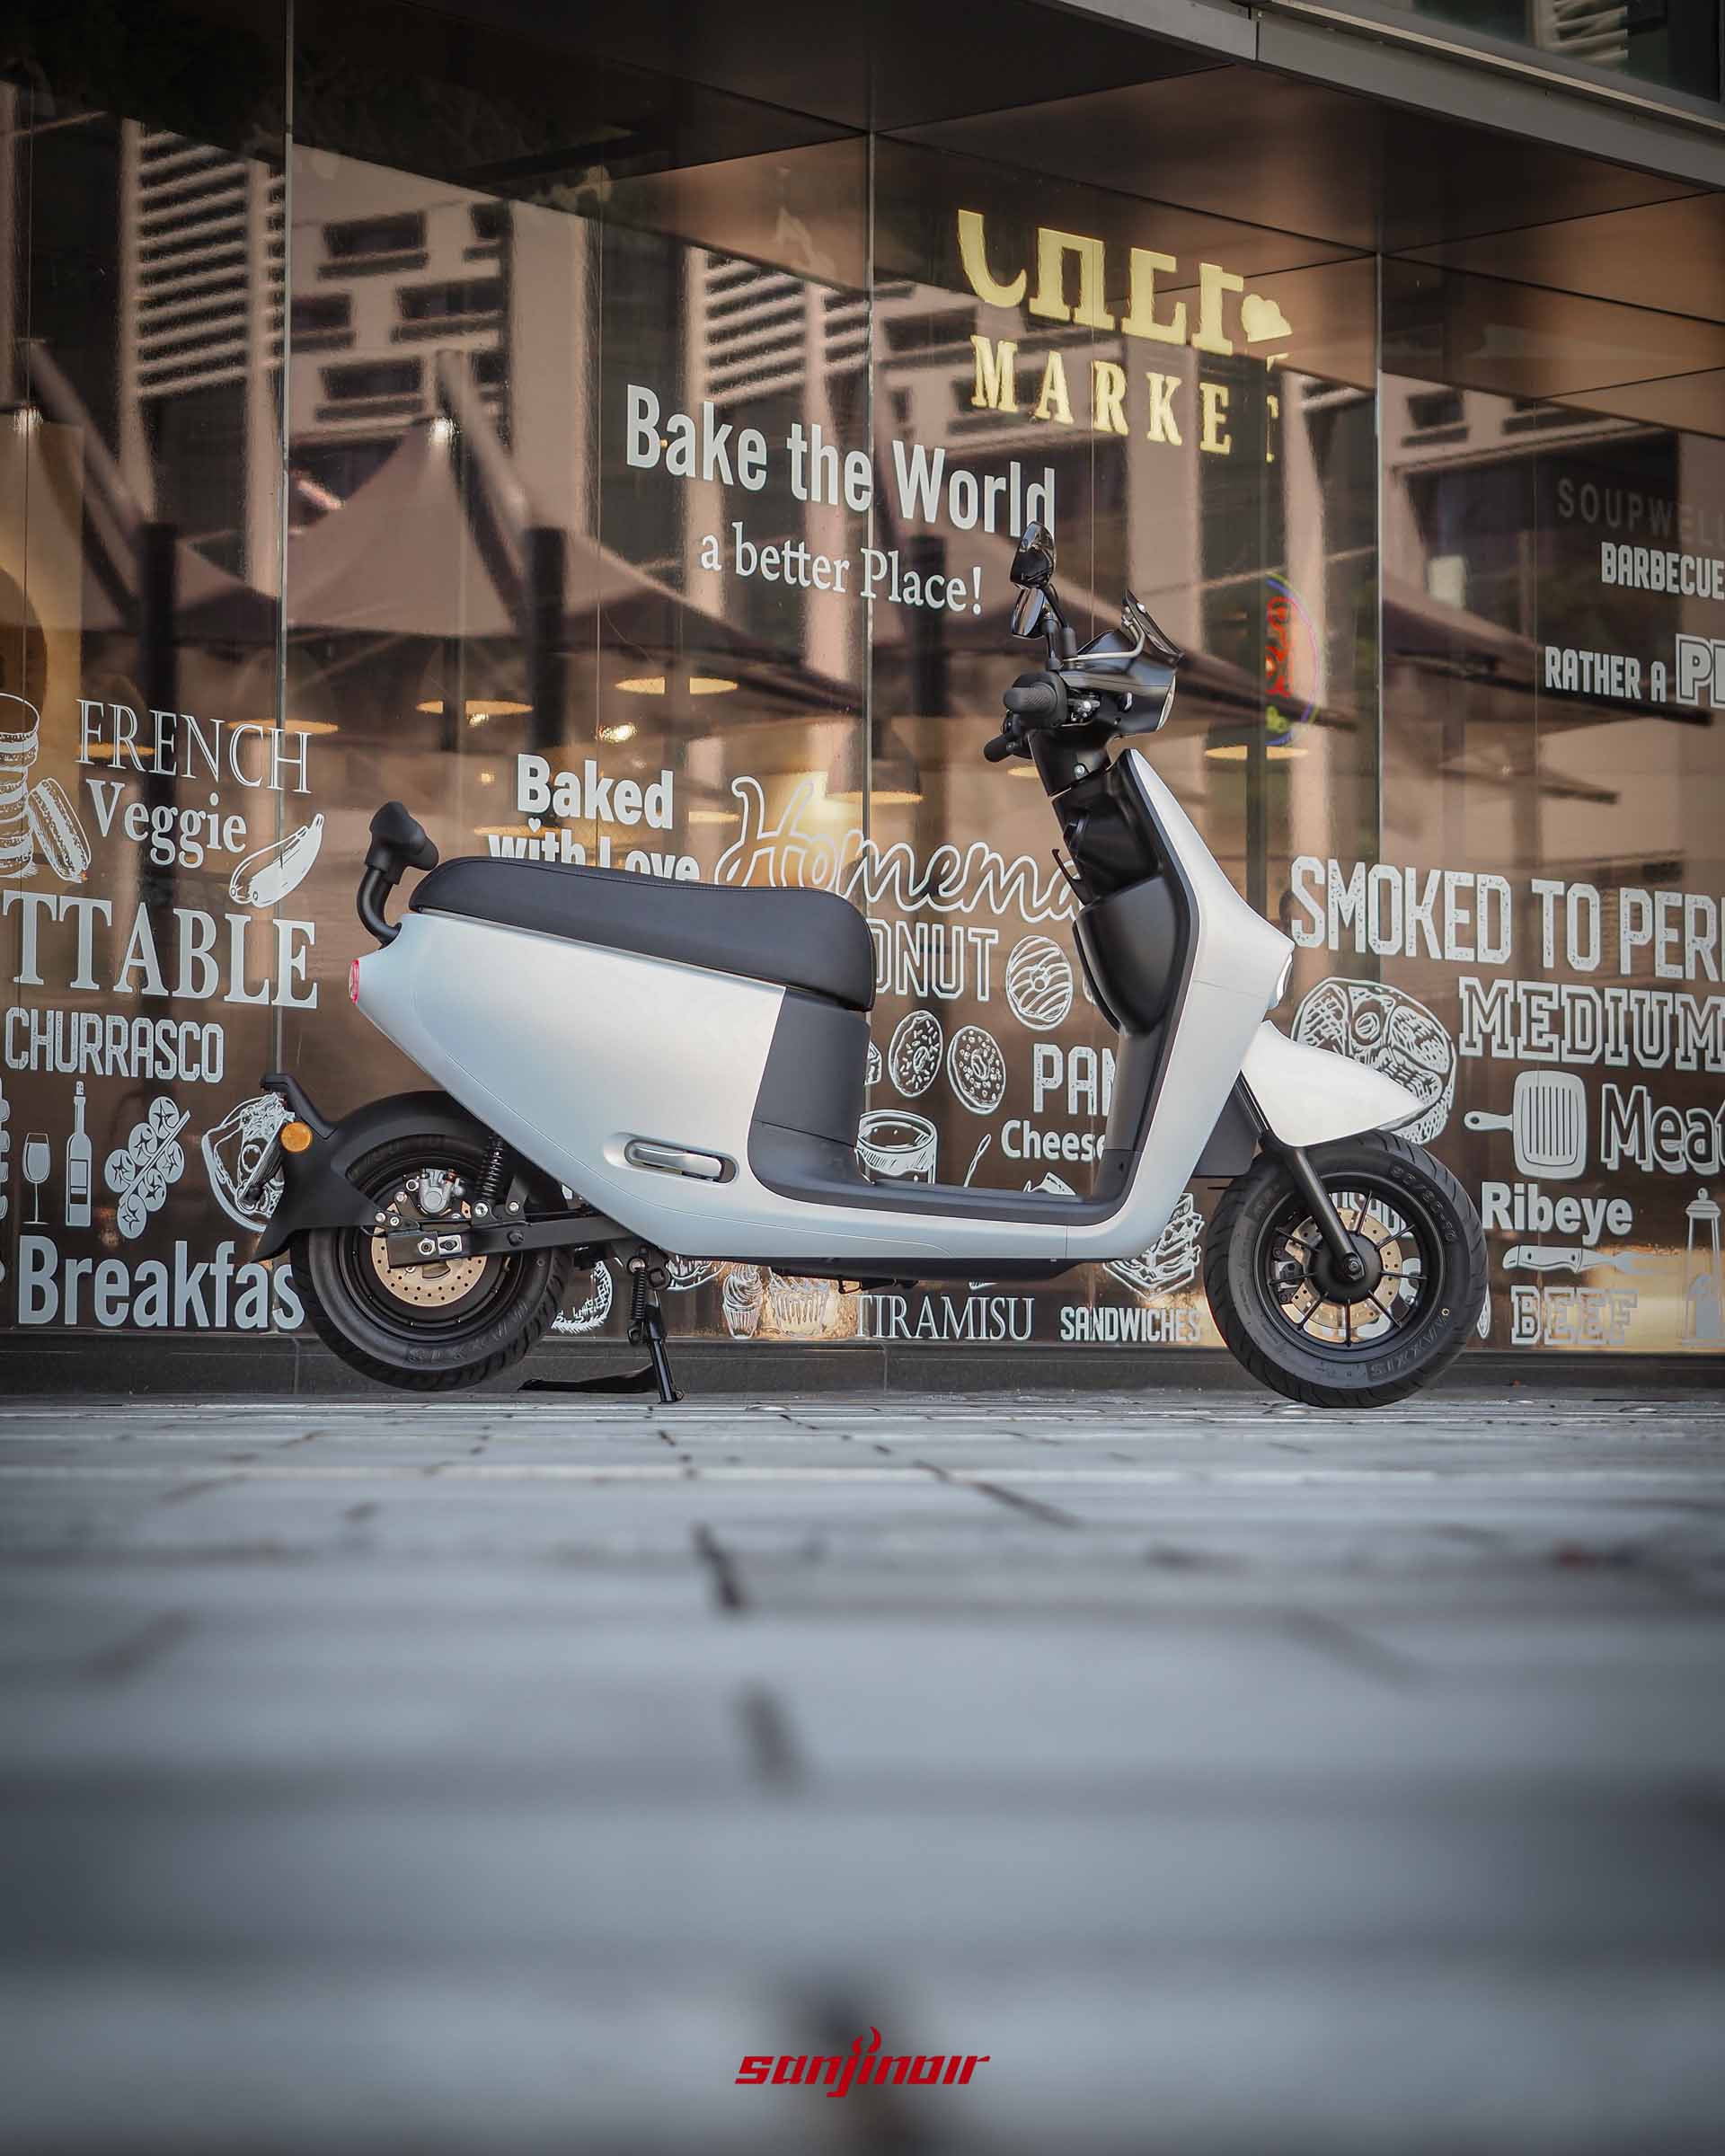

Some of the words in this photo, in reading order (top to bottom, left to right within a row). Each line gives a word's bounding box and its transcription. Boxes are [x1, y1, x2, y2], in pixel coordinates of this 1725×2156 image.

[971, 335, 1278, 463] MARKE
[627, 384, 767, 492] Bake
[786, 423, 872, 512] the
[893, 440, 1055, 539] World
[700, 532, 721, 571] a
[731, 521, 849, 595] better
[860, 547, 982, 615] Place!
[1601, 542, 1725, 601] BARBECUE
[1544, 646, 1641, 700] RATHER
[1650, 661, 1667, 703] A
[75, 698, 313, 794] FRENCH
[85, 778, 247, 869] Veggie
[518, 754, 673, 829] Baked
[3, 889, 318, 1009] TTABLE
[1291, 855, 1511, 965] SMOKED
[1531, 879, 1601, 972] TO
[1620, 887, 1725, 983] PER
[5, 1006, 224, 1083] CHURRASCO
[1458, 976, 1725, 1072] MEDIUM
[1482, 1181, 1632, 1245] Ribeye
[853, 1294, 1035, 1340] TIRAMISU
[1060, 1306, 1202, 1342] SANDWICHES
[1511, 1285, 1639, 1346] BEEF
